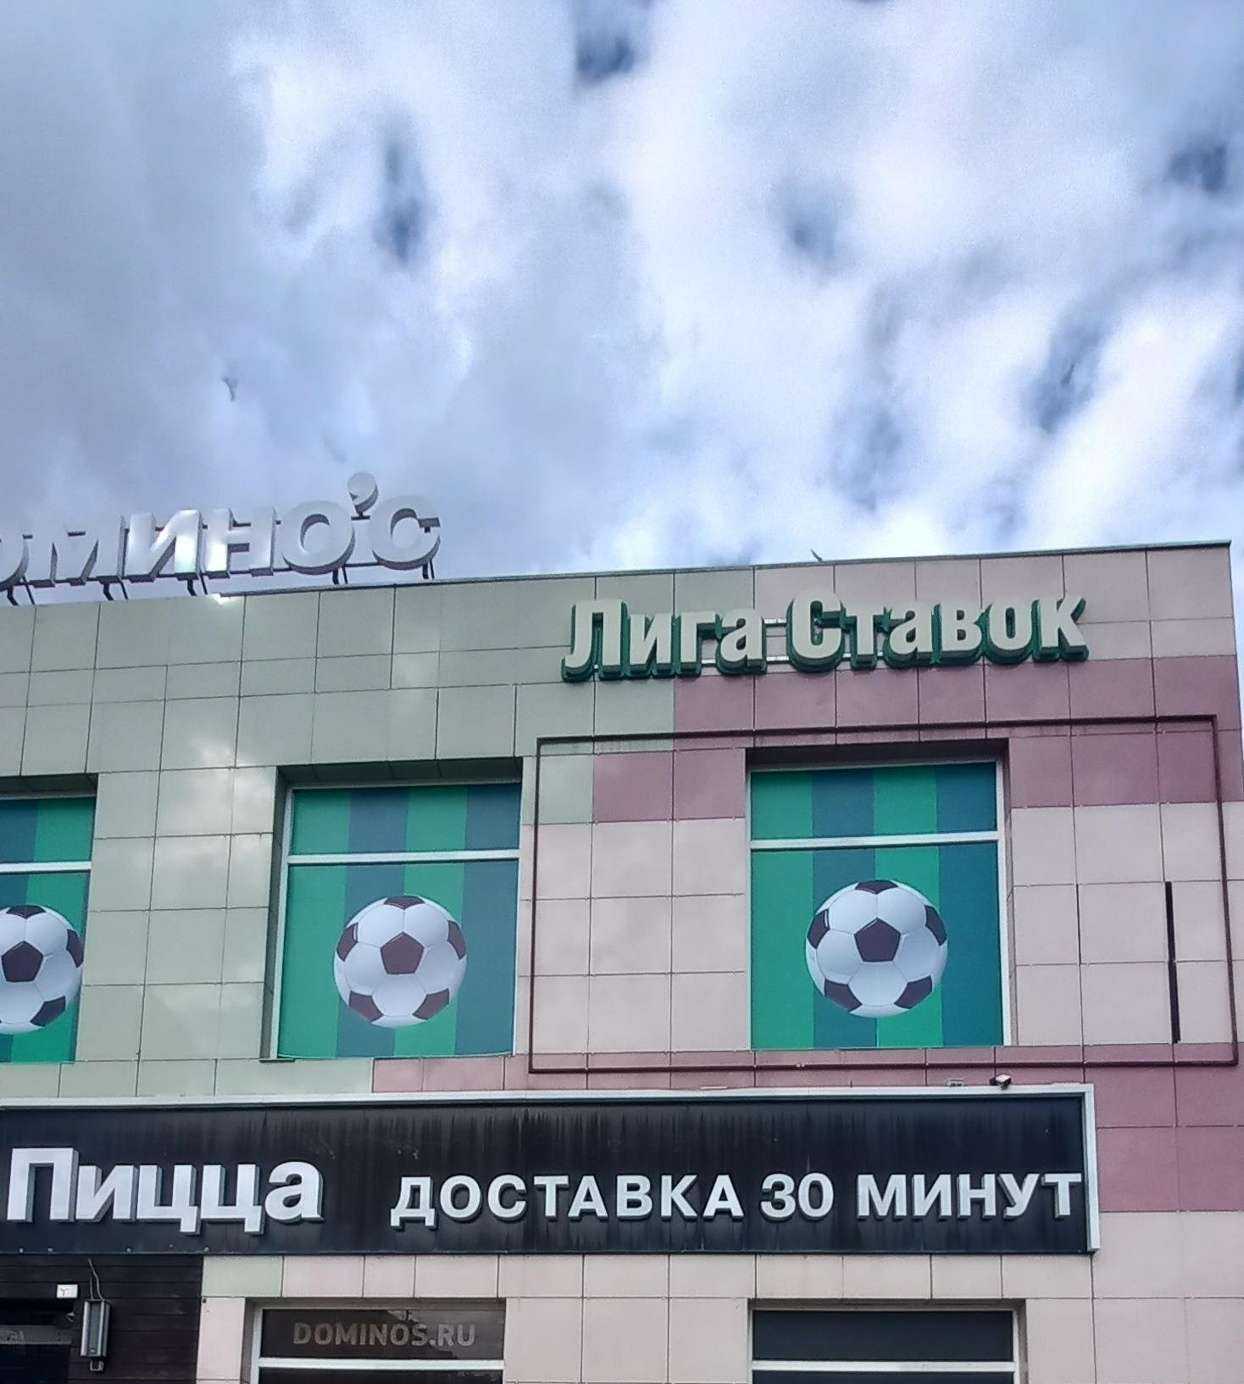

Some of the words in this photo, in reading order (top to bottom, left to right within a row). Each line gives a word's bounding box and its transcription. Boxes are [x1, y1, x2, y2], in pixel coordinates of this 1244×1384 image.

[562, 598, 767, 681] Лига
[786, 593, 1089, 673] Ставок
[6, 1147, 325, 1236] Пицца
[390, 1174, 746, 1229] ДОСТАВКА
[760, 1172, 836, 1220] 30
[856, 1173, 1083, 1219] МИНУТ
[293, 1323, 475, 1346] DOMINOS.RU
